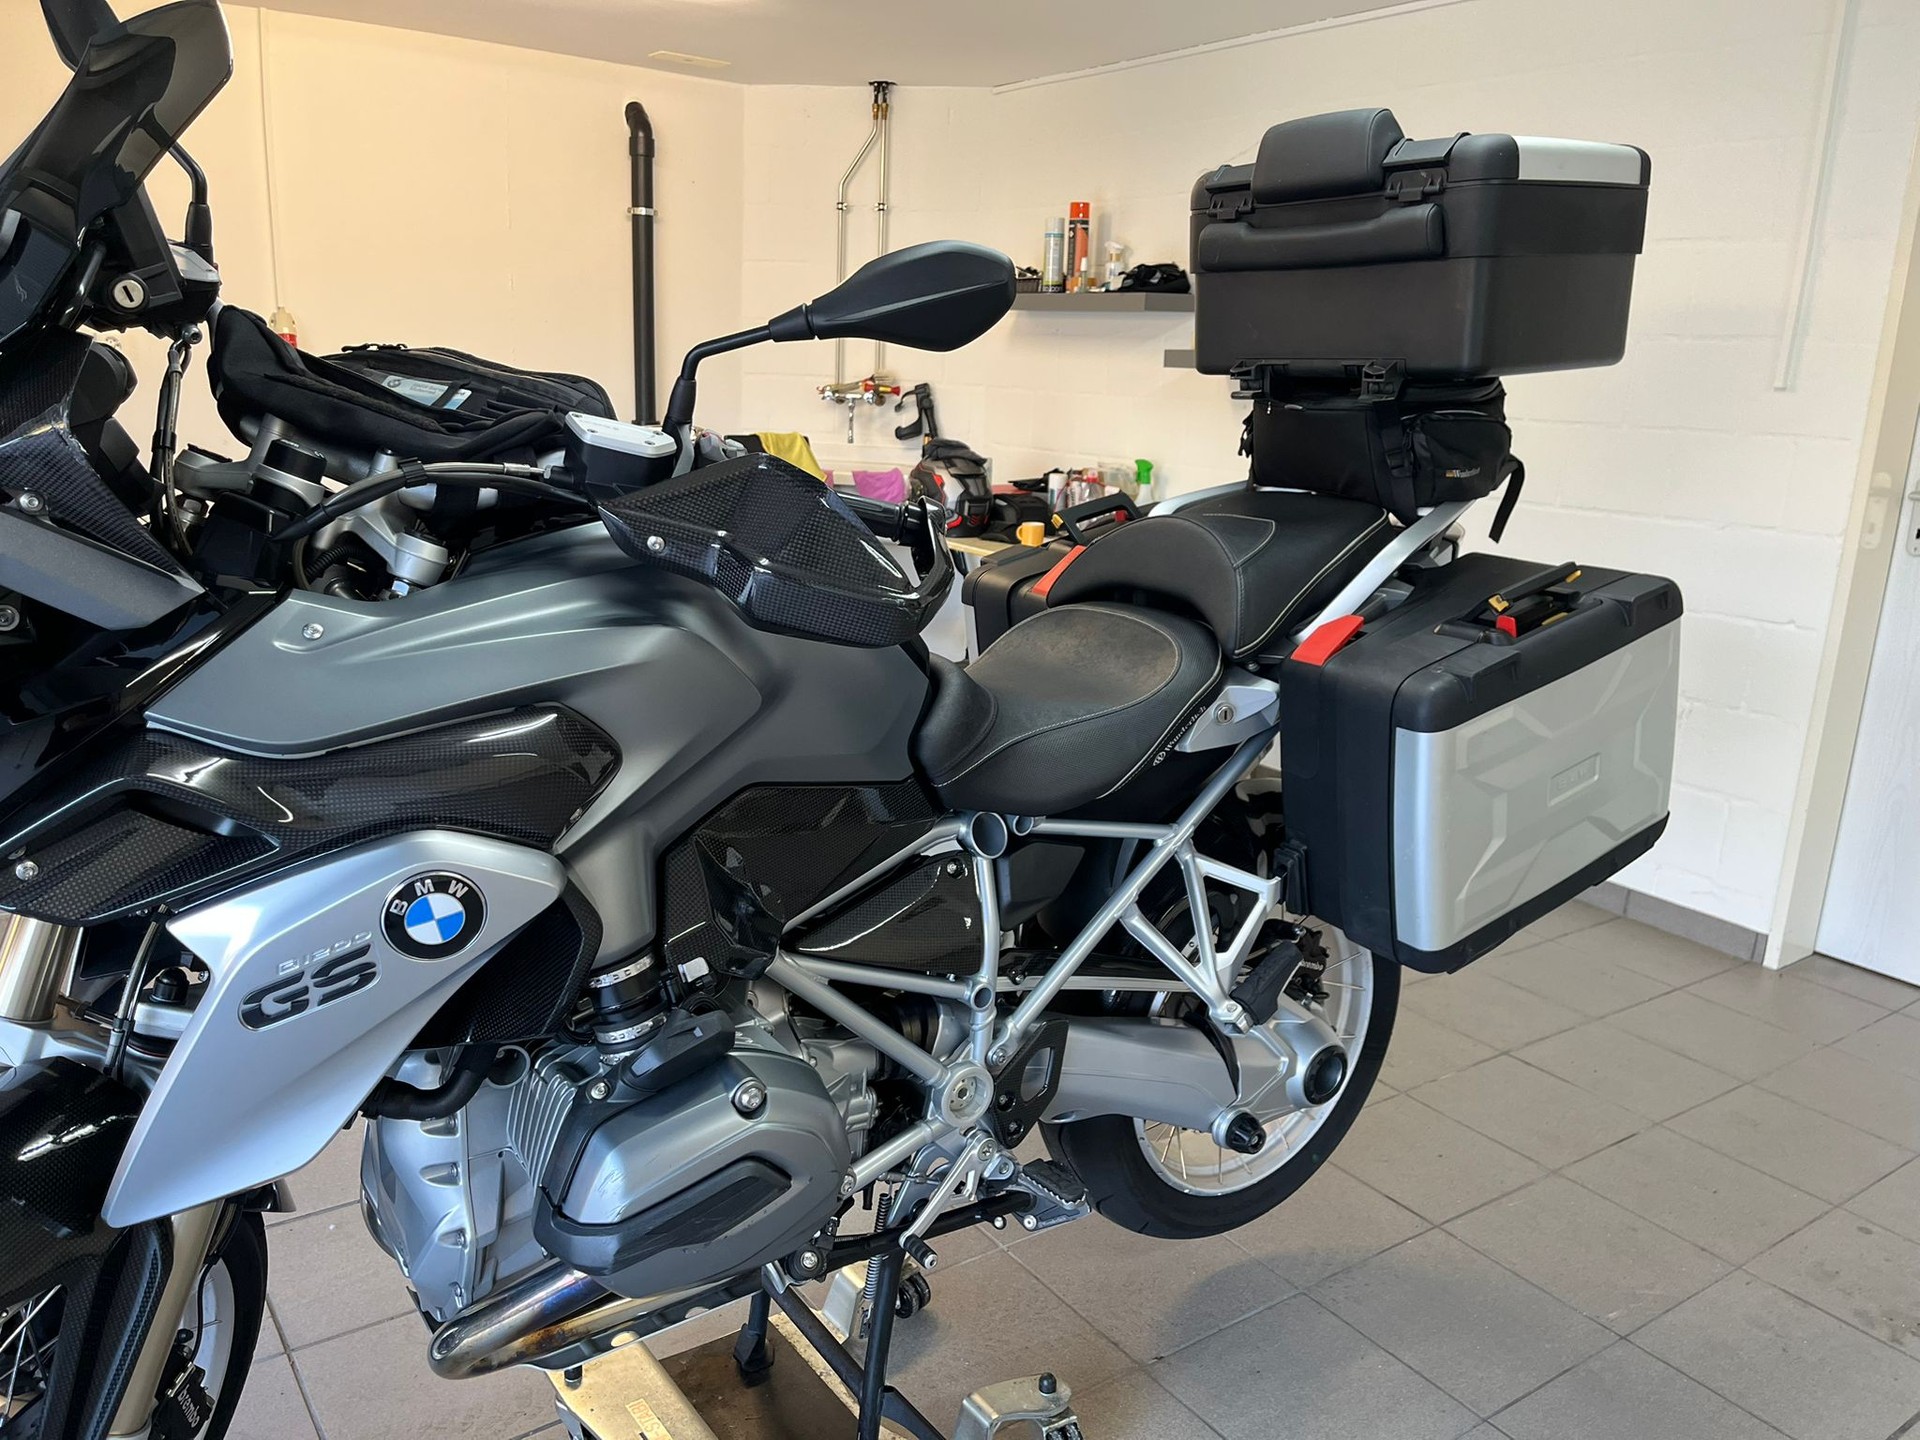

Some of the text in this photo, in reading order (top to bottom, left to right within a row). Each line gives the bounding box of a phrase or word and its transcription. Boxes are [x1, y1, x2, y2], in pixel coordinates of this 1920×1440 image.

[1164, 705, 1206, 751] Wunderlich
[389, 878, 470, 916] BMW
[279, 931, 372, 976] R1200
[240, 942, 379, 1030] GS
[177, 1384, 200, 1428] brembo
